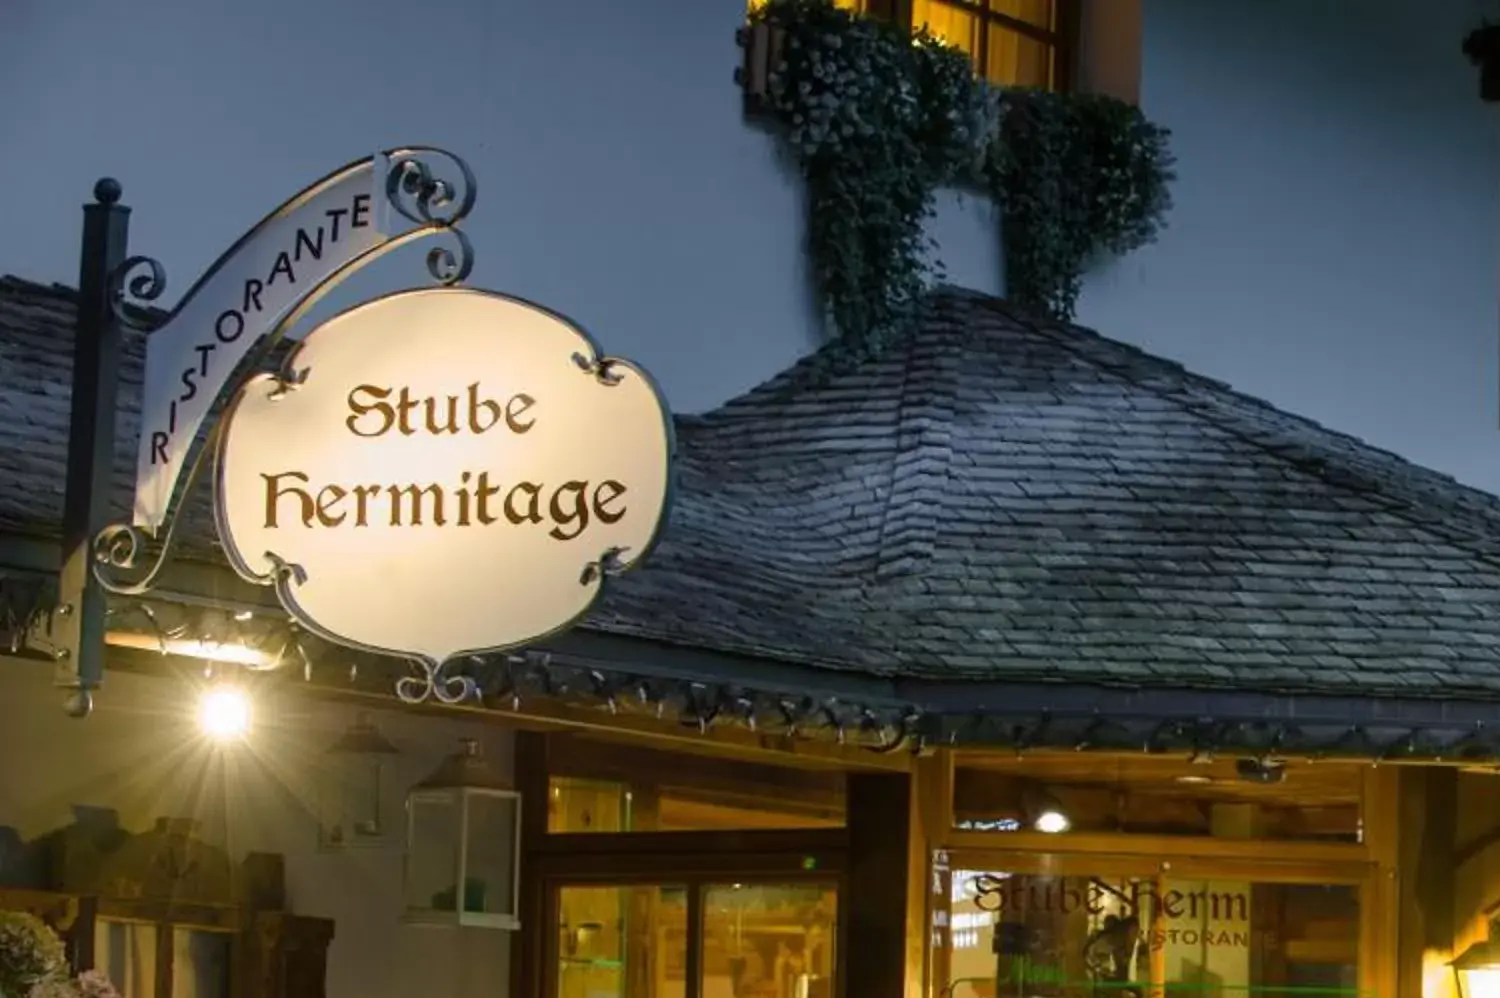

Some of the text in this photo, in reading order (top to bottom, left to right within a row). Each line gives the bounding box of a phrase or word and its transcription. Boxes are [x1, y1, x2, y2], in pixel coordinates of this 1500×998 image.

[151, 194, 371, 464] RISTORANTE
[345, 381, 537, 437] Stube
[259, 470, 628, 542] Hermitage
[973, 874, 1105, 914] Stube
